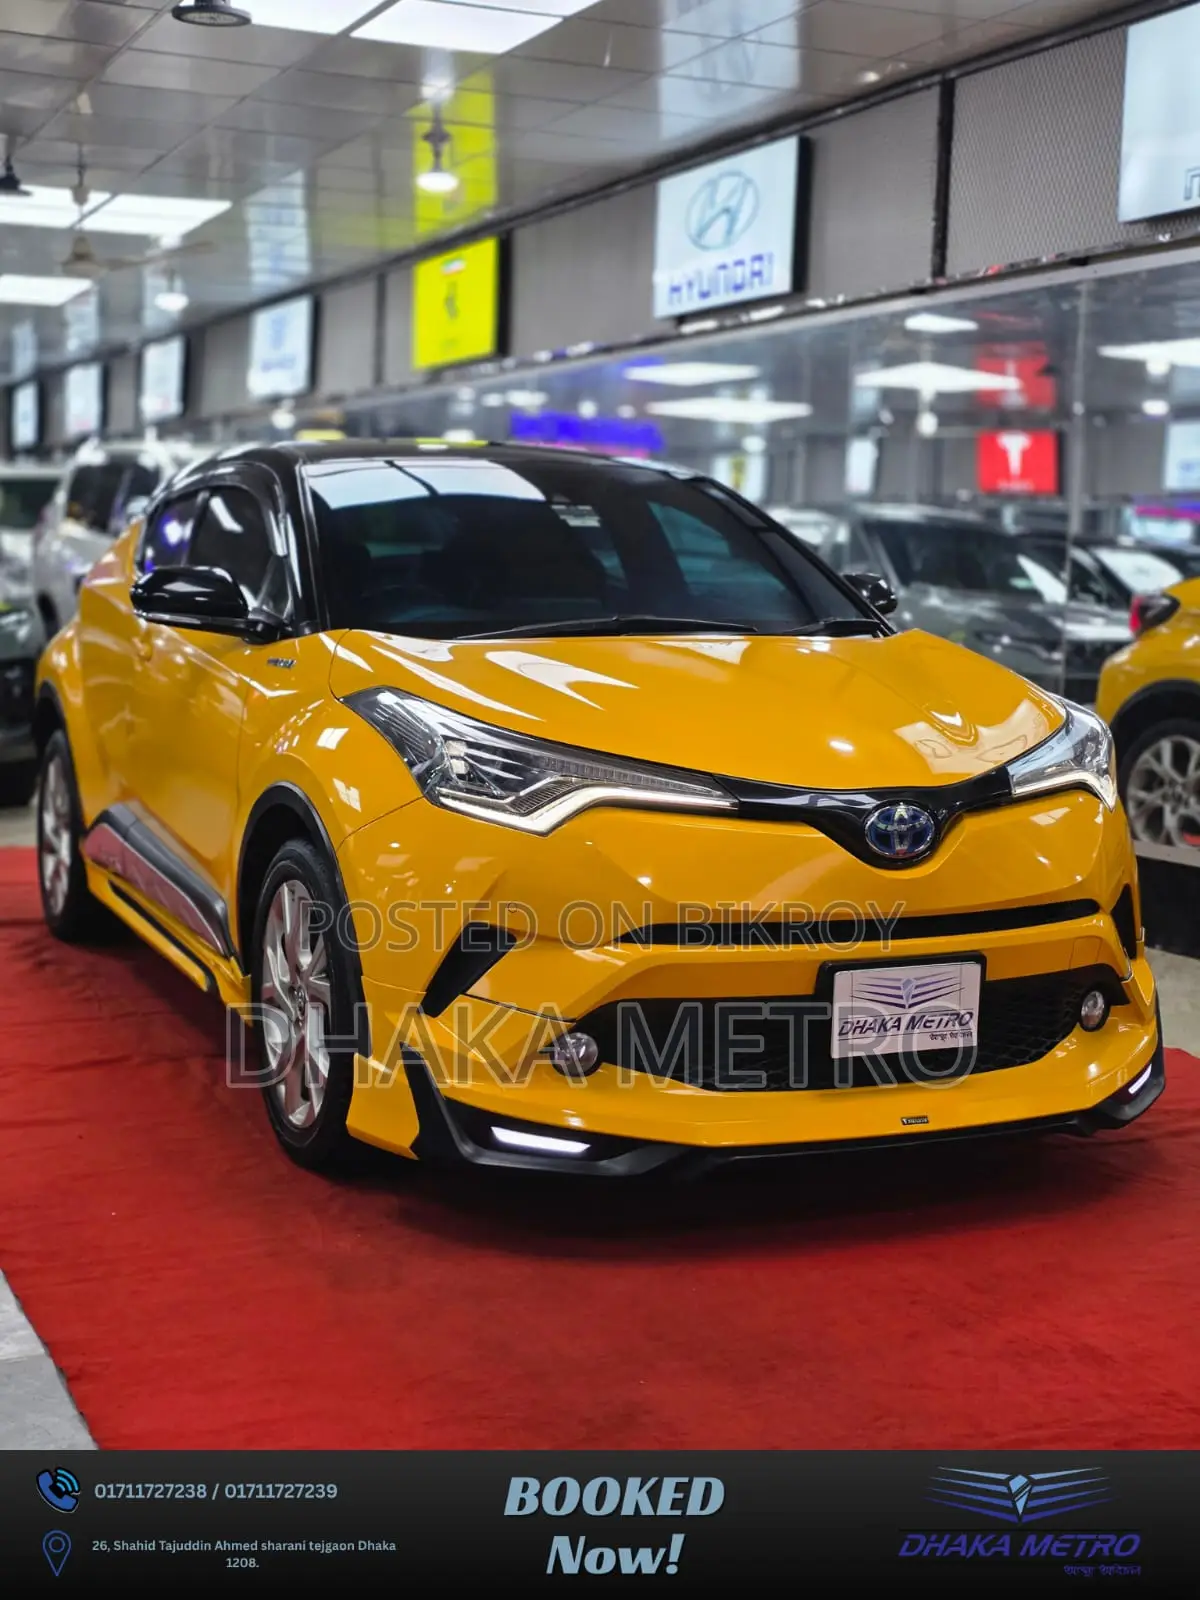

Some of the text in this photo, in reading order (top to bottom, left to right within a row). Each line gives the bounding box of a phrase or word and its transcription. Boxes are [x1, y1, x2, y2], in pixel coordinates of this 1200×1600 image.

[668, 252, 774, 305] HYUNDAI
[838, 1011, 974, 1036] DHAKA METRO
